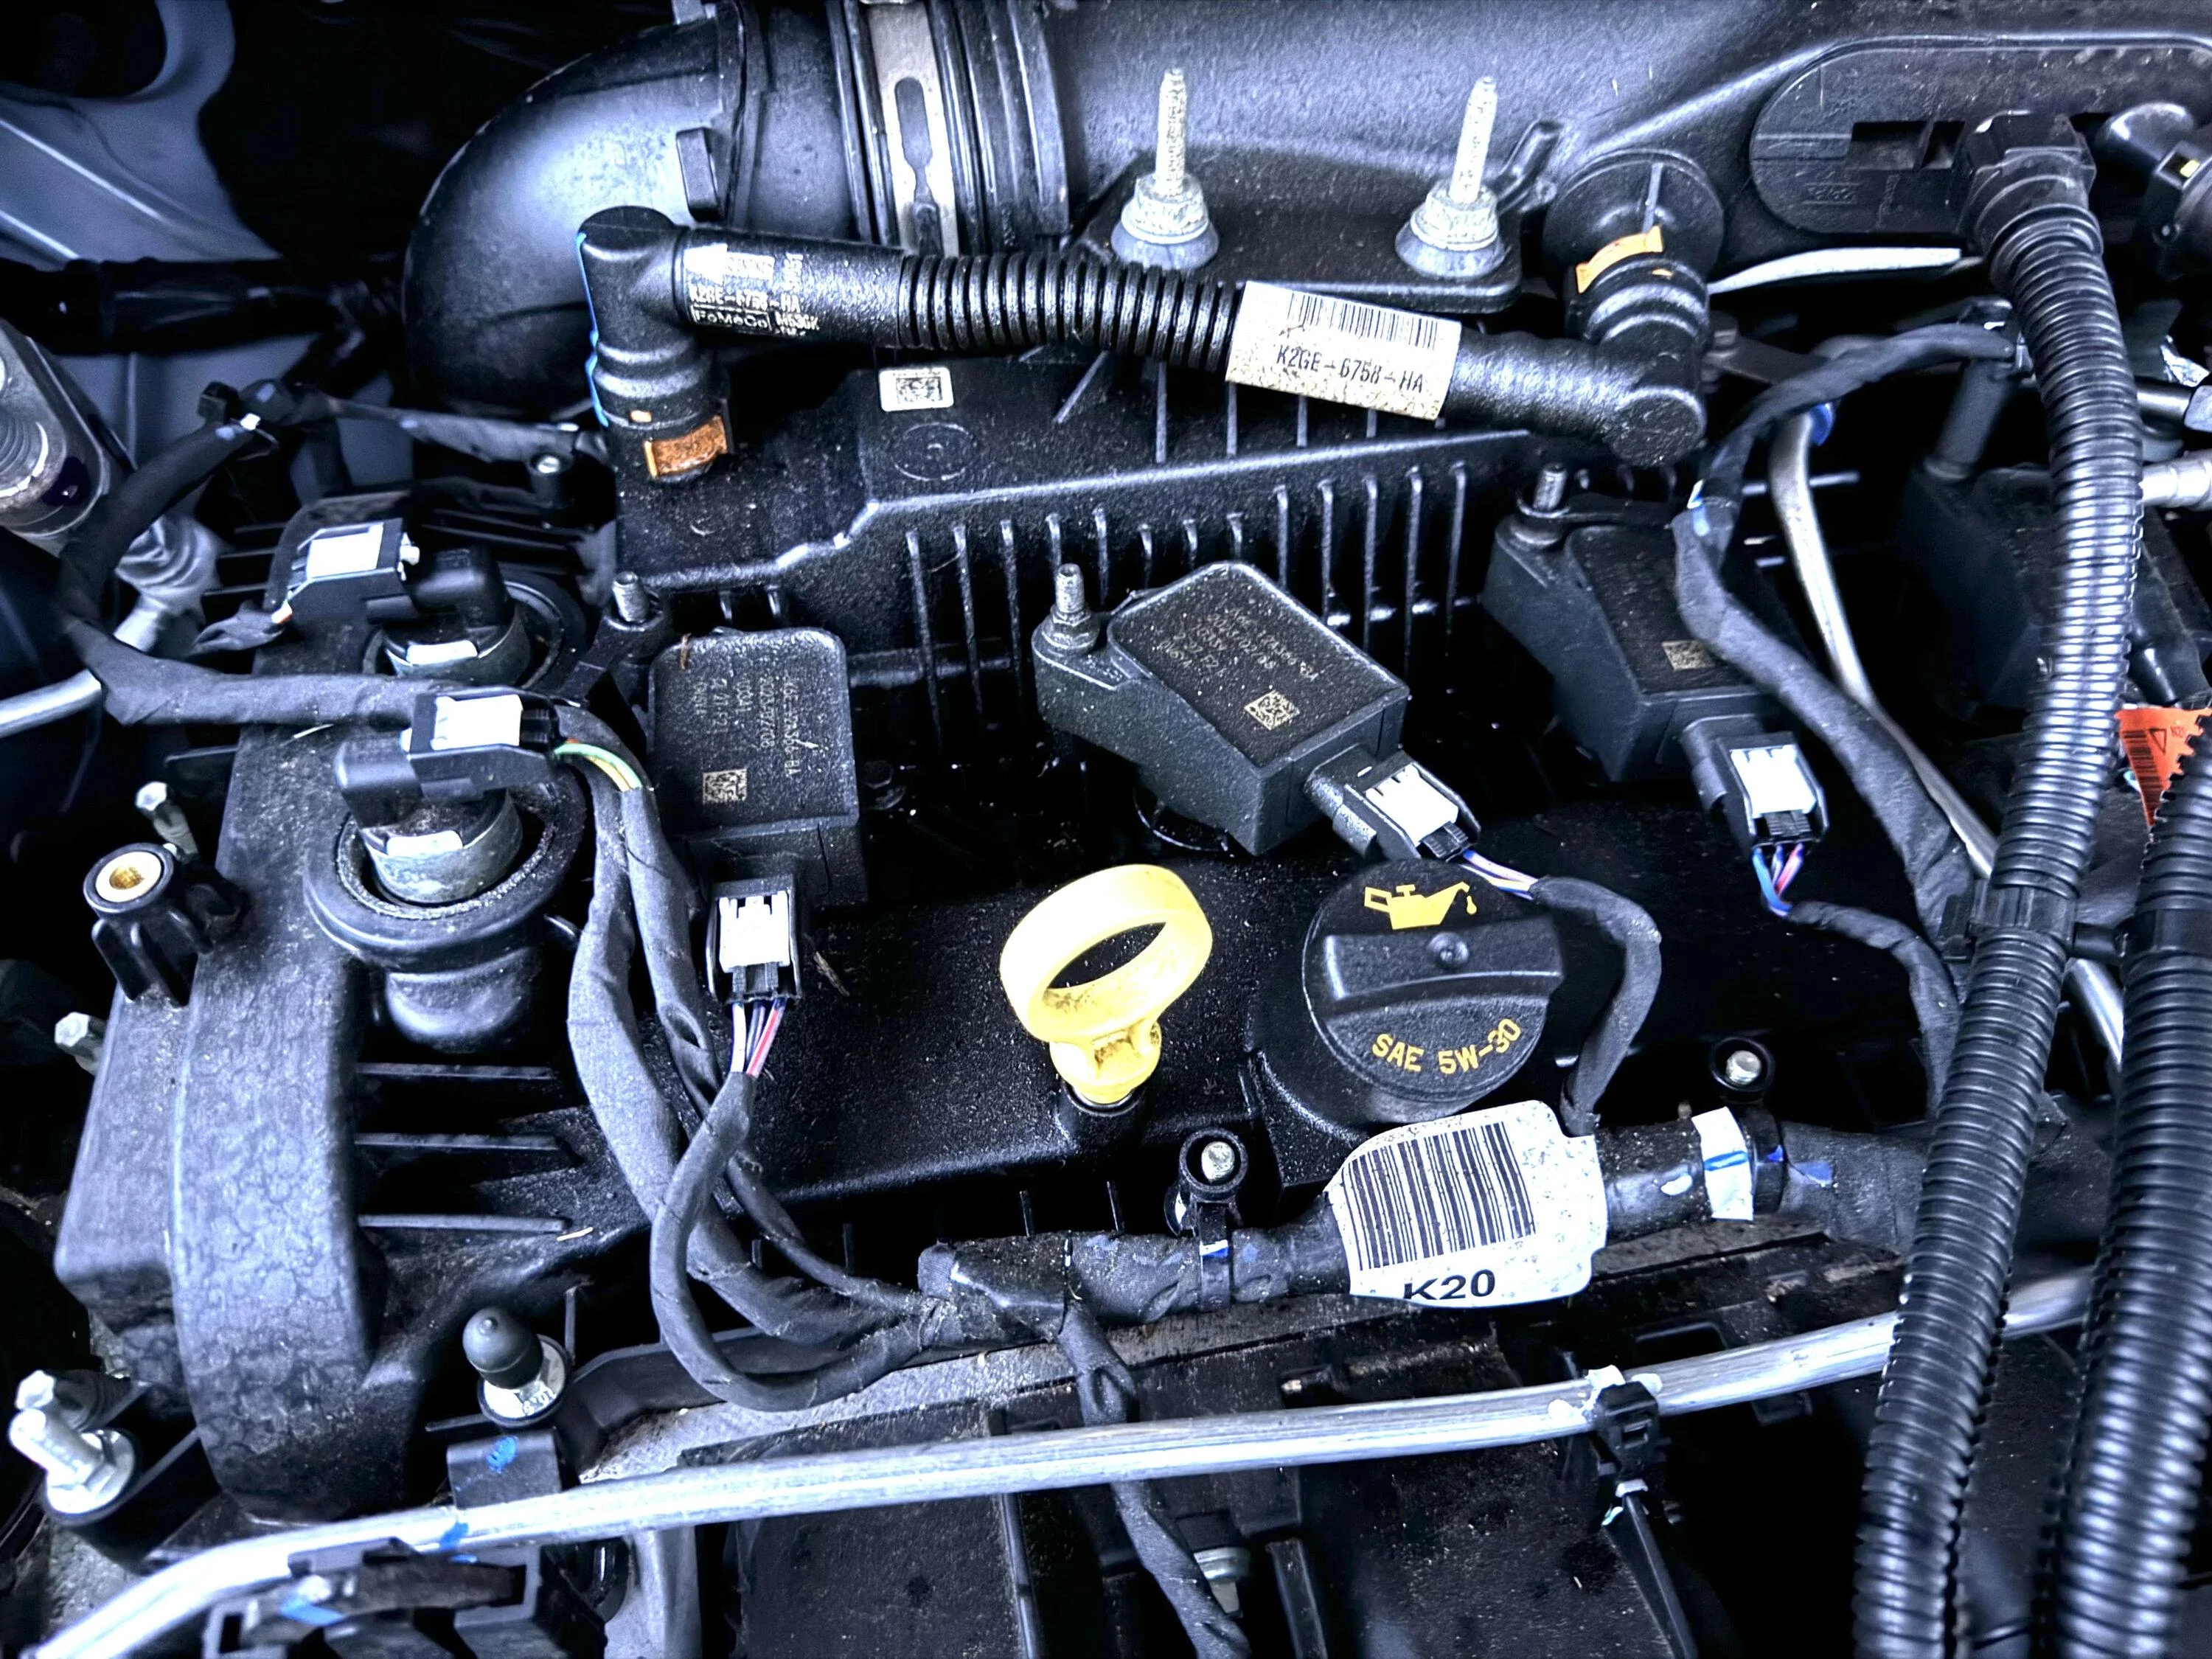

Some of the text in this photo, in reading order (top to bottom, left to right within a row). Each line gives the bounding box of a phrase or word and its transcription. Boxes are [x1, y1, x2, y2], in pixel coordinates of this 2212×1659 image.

[695, 310, 768, 329] FoMoCo
[1372, 1018, 1521, 1075] SAE 5W-30
[1403, 1269, 1497, 1301] K20
